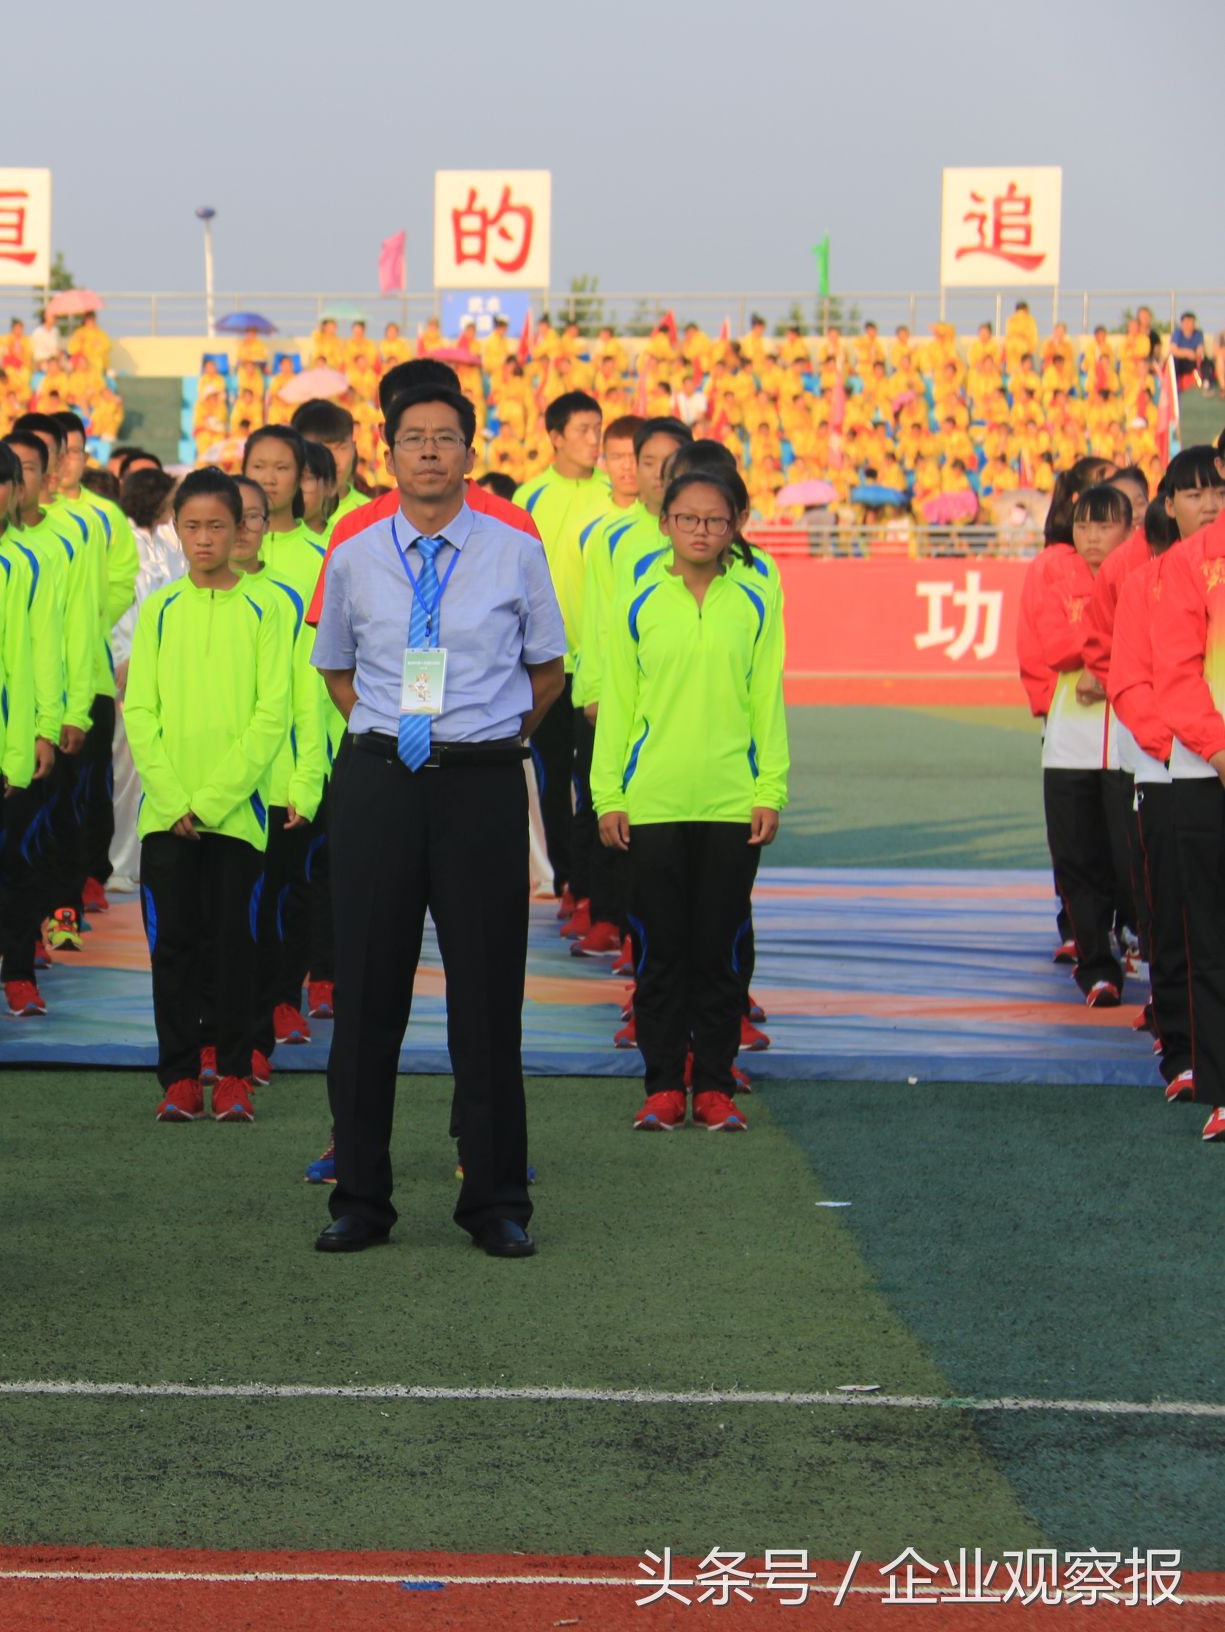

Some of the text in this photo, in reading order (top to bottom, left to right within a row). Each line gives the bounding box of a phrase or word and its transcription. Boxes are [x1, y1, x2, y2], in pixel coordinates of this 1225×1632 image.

[451, 185, 535, 275] 的
[955, 181, 1047, 272] 追
[914, 571, 1004, 661] 功
